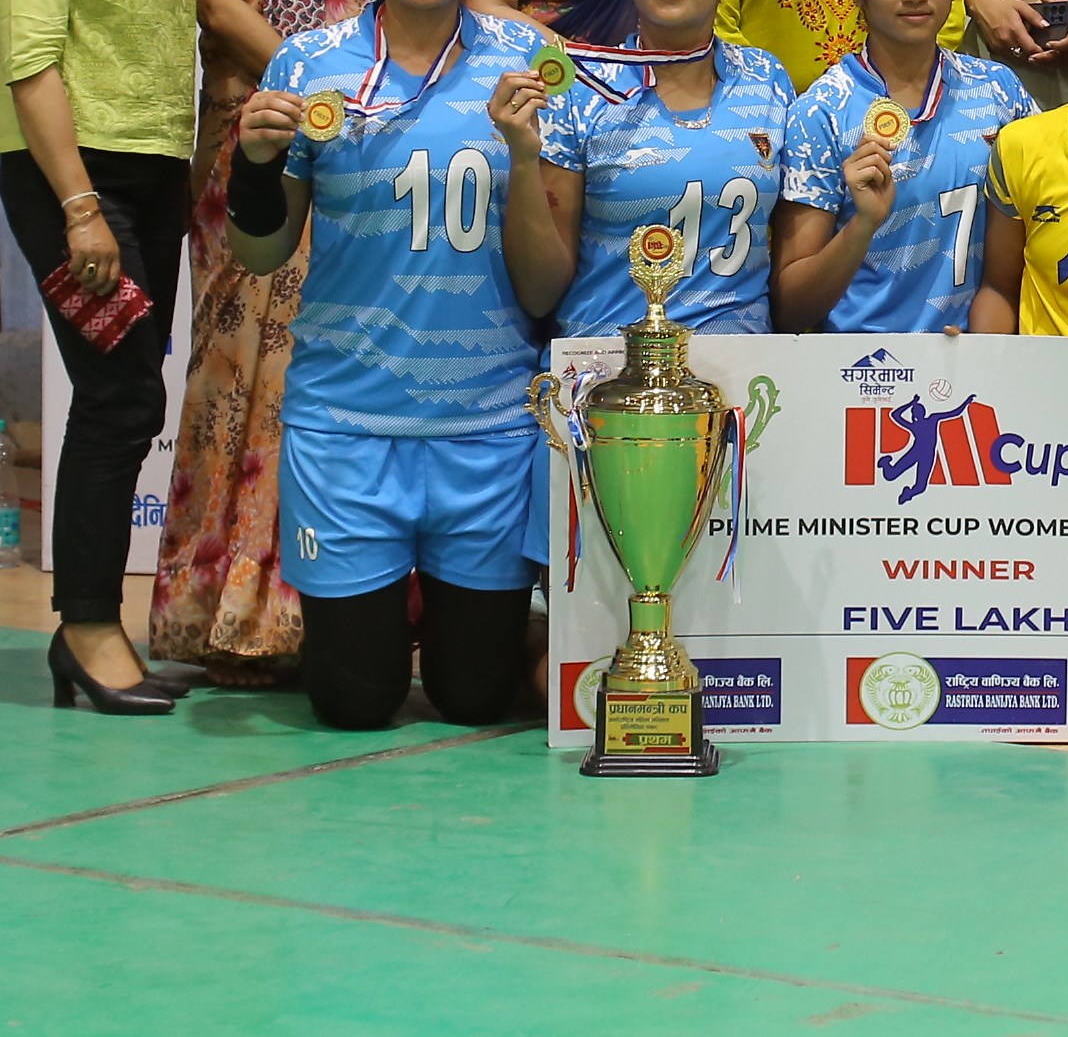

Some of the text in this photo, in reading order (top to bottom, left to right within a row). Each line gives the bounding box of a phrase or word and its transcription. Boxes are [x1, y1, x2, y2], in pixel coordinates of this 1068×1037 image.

[393, 147, 492, 253] 10
[669, 177, 759, 278] 13
[939, 184, 978, 288] 7
[840, 368, 915, 382] सगरमाथा
[859, 383, 895, 395] सिमेन्ट
[799, 518, 919, 536] MINISTER
[926, 518, 980, 536] CUP
[296, 527, 319, 561] 10
[882, 560, 1035, 580] WINNER
[843, 606, 940, 631] FIVE
[982, 674, 1020, 687] वाणिज्य
[734, 695, 755, 708] BANK
[756, 695, 773, 708] LTD.
[946, 695, 1060, 708] RASTRIYA BANIJYA BANK LTD.
